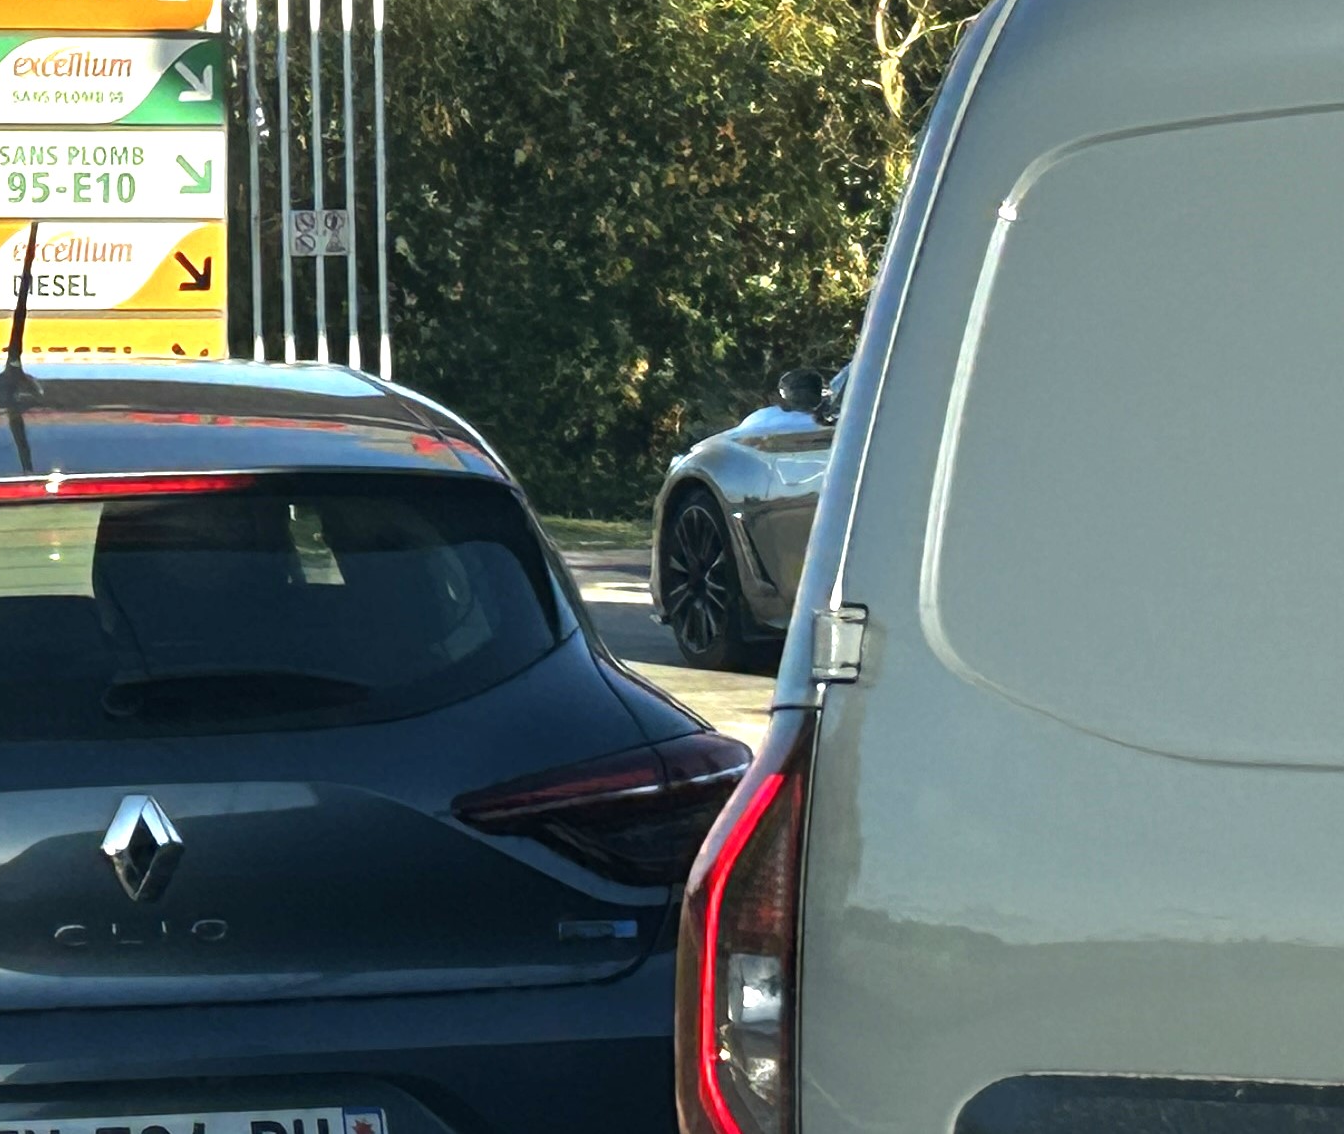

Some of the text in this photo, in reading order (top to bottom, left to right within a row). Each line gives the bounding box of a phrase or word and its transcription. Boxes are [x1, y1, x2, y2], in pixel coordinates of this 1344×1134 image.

[0, 146, 145, 166] SANS PLOMB
[7, 172, 136, 203] 95-E10
[53, 918, 228, 946] CLIO
